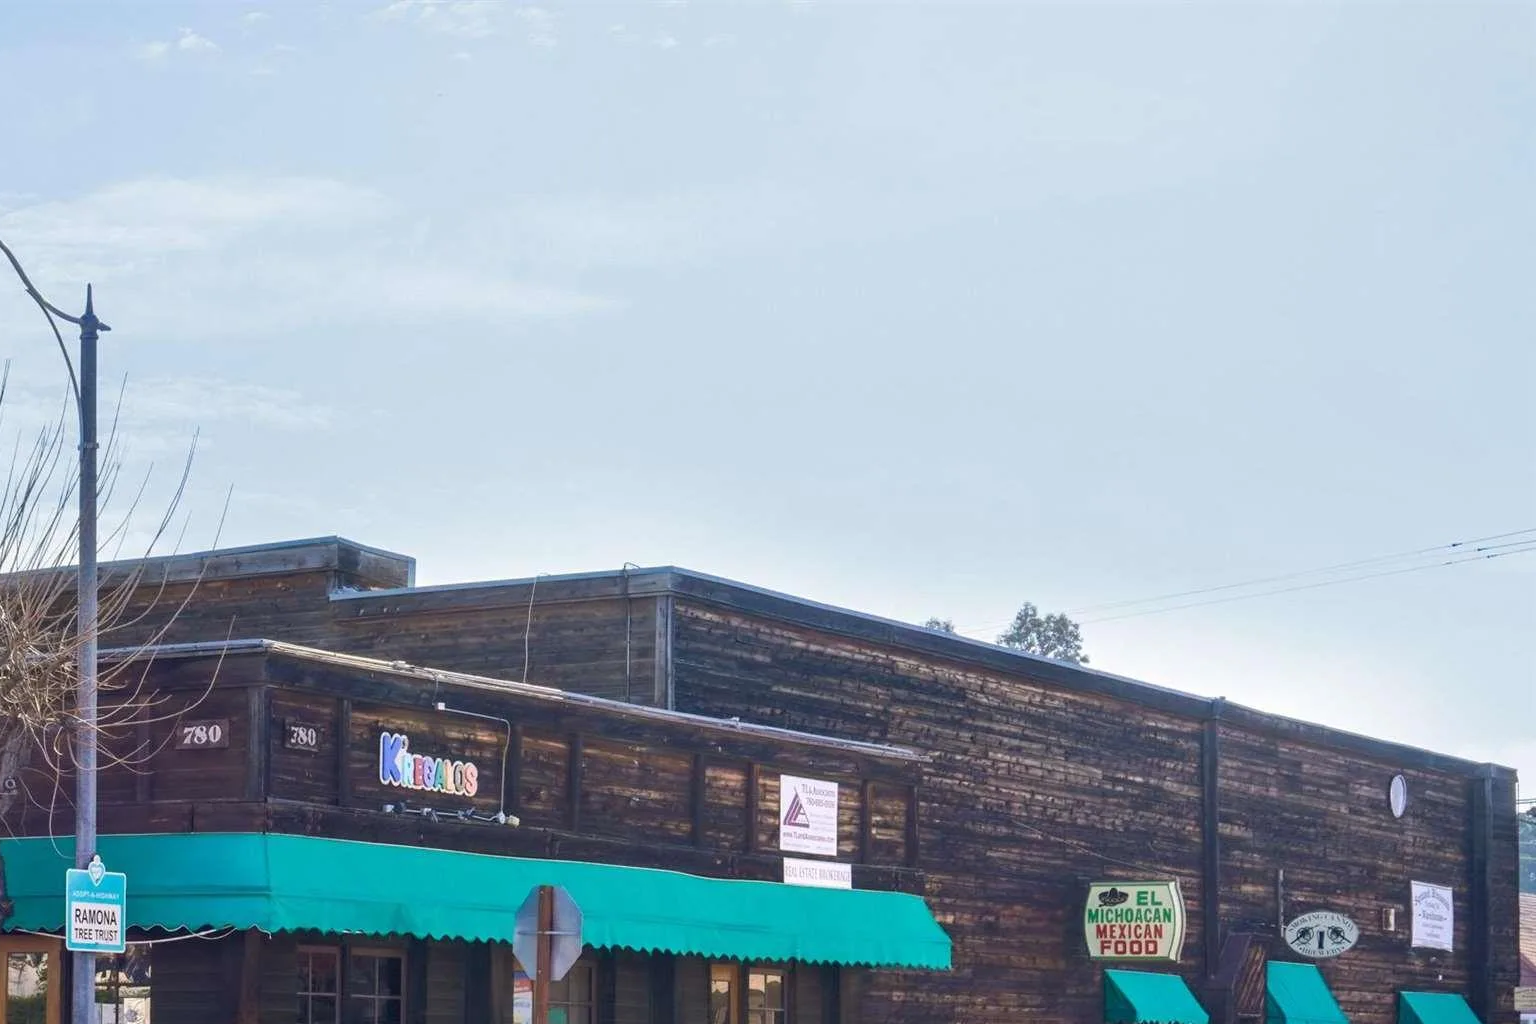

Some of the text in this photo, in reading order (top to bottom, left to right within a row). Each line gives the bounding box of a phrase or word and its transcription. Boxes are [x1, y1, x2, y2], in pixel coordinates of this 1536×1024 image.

[183, 724, 222, 745] 780
[290, 725, 316, 746] 780
[785, 864, 798, 878] REAL
[799, 866, 818, 880] ESTATE
[1136, 890, 1163, 906] EL
[74, 908, 118, 926] RAMONA
[1087, 908, 1172, 924] MICHOACAN
[74, 927, 118, 942] TREE TRUST
[1095, 924, 1163, 939] MEXICAN
[1100, 940, 1158, 955] FOOD
